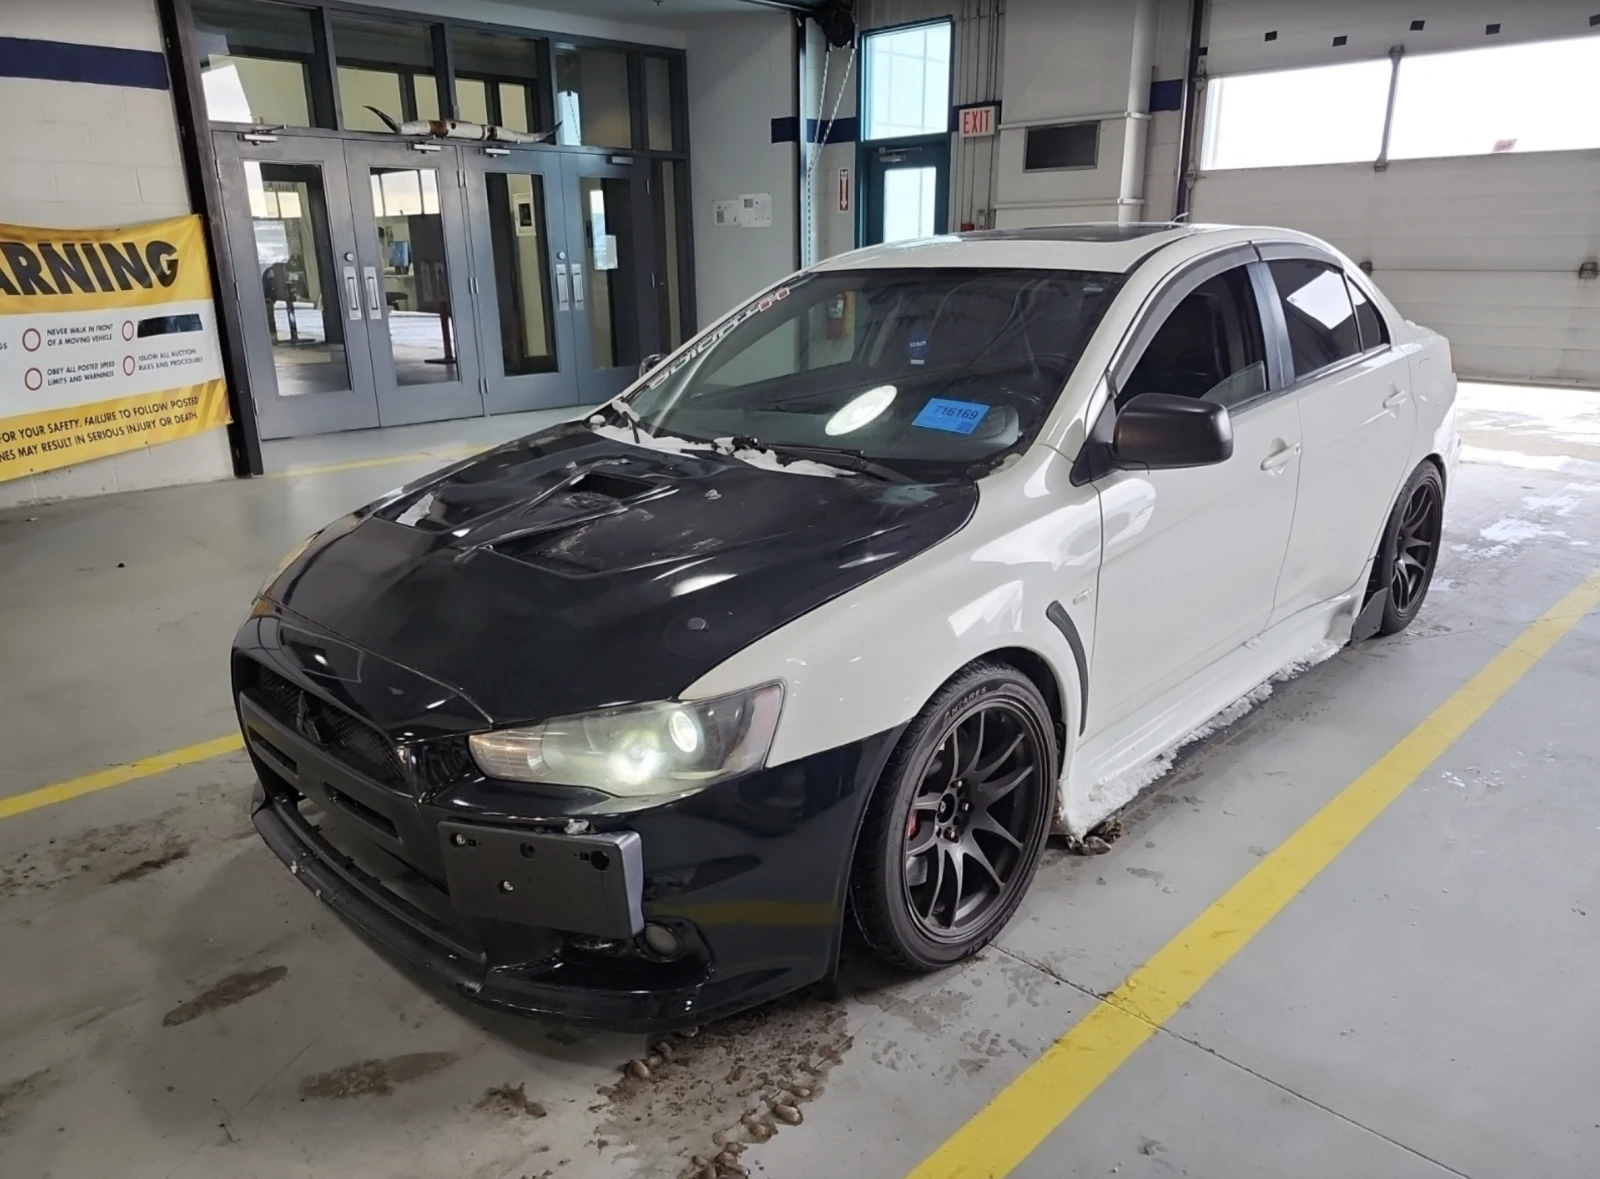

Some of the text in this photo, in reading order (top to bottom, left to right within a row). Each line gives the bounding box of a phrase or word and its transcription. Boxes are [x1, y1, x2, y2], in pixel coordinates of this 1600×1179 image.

[963, 109, 990, 134] EXIT
[46, 327, 68, 336] NEVER
[69, 326, 86, 334] WALK
[95, 323, 114, 332] FRONT
[47, 339, 56, 347] OF
[65, 335, 91, 345] MOVING
[160, 351, 170, 359] ALL
[171, 348, 196, 357] AUCTION
[47, 368, 64, 376] OBEY
[65, 366, 76, 374] ALL
[78, 363, 98, 373] POSTED
[47, 370, 115, 387] LIMITS AND WARNINGS
[18, 425, 46, 440] YOUR
[47, 418, 82, 434] SAFETY.
[84, 411, 117, 427] FAILURE
[118, 408, 131, 419] TO
[132, 402, 168, 416] FOLLOW
[170, 396, 199, 409] POSTED
[932, 405, 979, 420] 716169
[17, 444, 38, 458] MAY
[41, 437, 73, 453] RESULT
[74, 434, 86, 445] IN
[87, 426, 125, 443] SERIOUS
[125, 419, 156, 434] INJURY
[159, 416, 173, 427] OR
